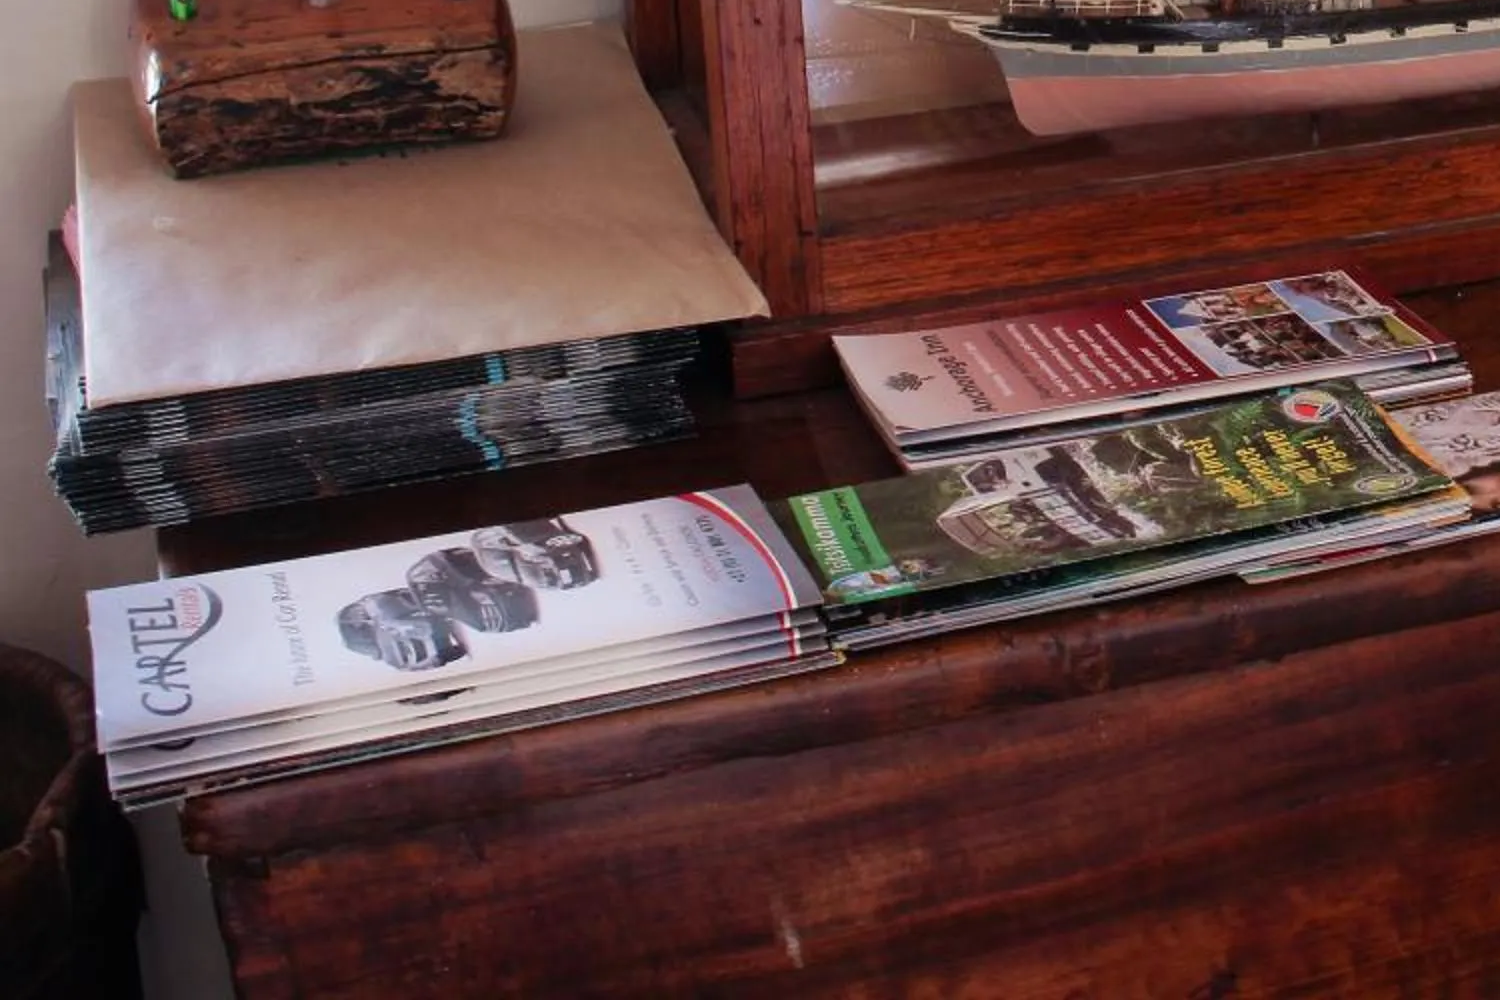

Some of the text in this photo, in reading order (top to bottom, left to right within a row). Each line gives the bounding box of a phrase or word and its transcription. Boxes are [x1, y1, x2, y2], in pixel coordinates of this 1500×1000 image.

[920, 334, 949, 358] Inn
[937, 355, 998, 413] Anchorage
[801, 495, 855, 575] Tsitsikamma
[176, 585, 203, 633] Rentals
[126, 597, 193, 717] CARTEL
